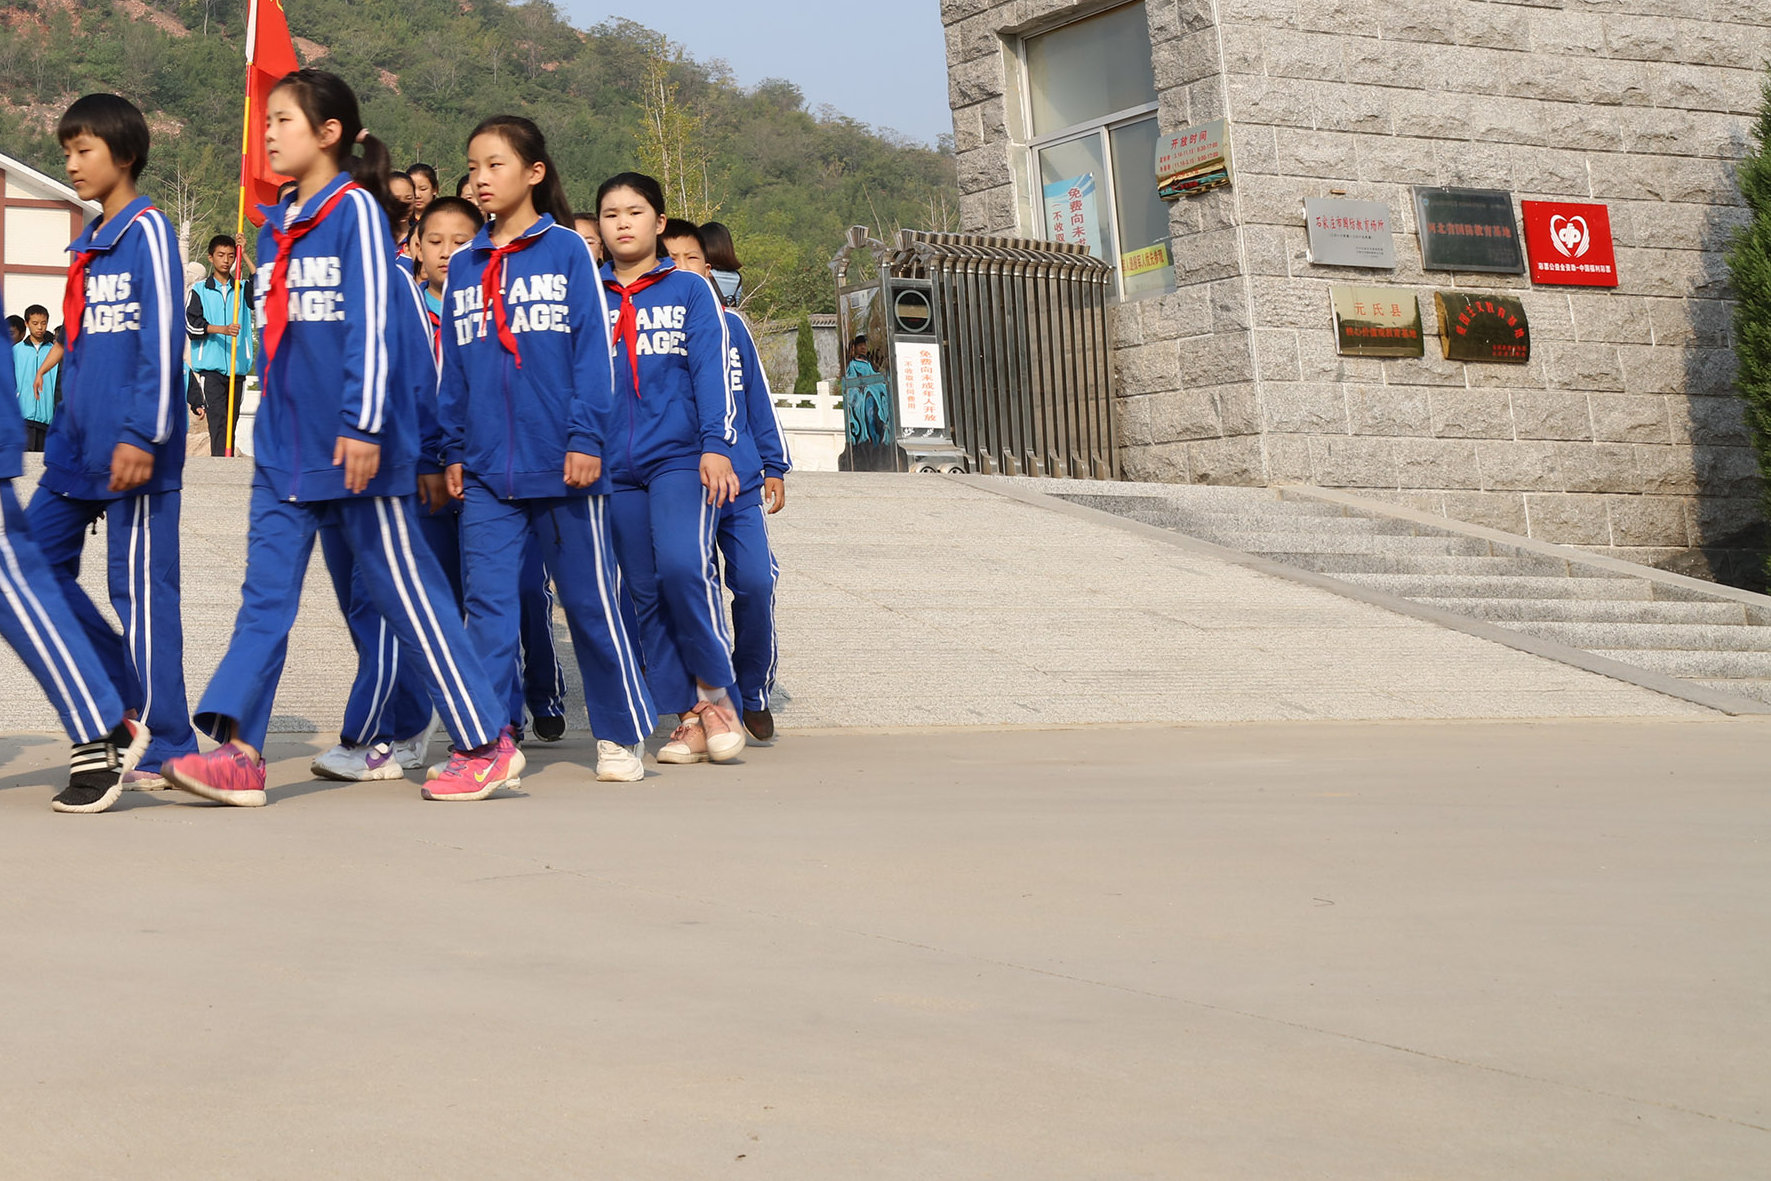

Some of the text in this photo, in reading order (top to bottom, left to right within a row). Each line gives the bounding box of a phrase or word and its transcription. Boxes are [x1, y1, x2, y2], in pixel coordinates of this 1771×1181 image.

[1171, 130, 1208, 150] 开放时间
[1427, 221, 1513, 238] 河北省国防教育基地
[1354, 302, 1402, 318] 元氏县
[919, 349, 937, 422] 免费向未成年人开放
